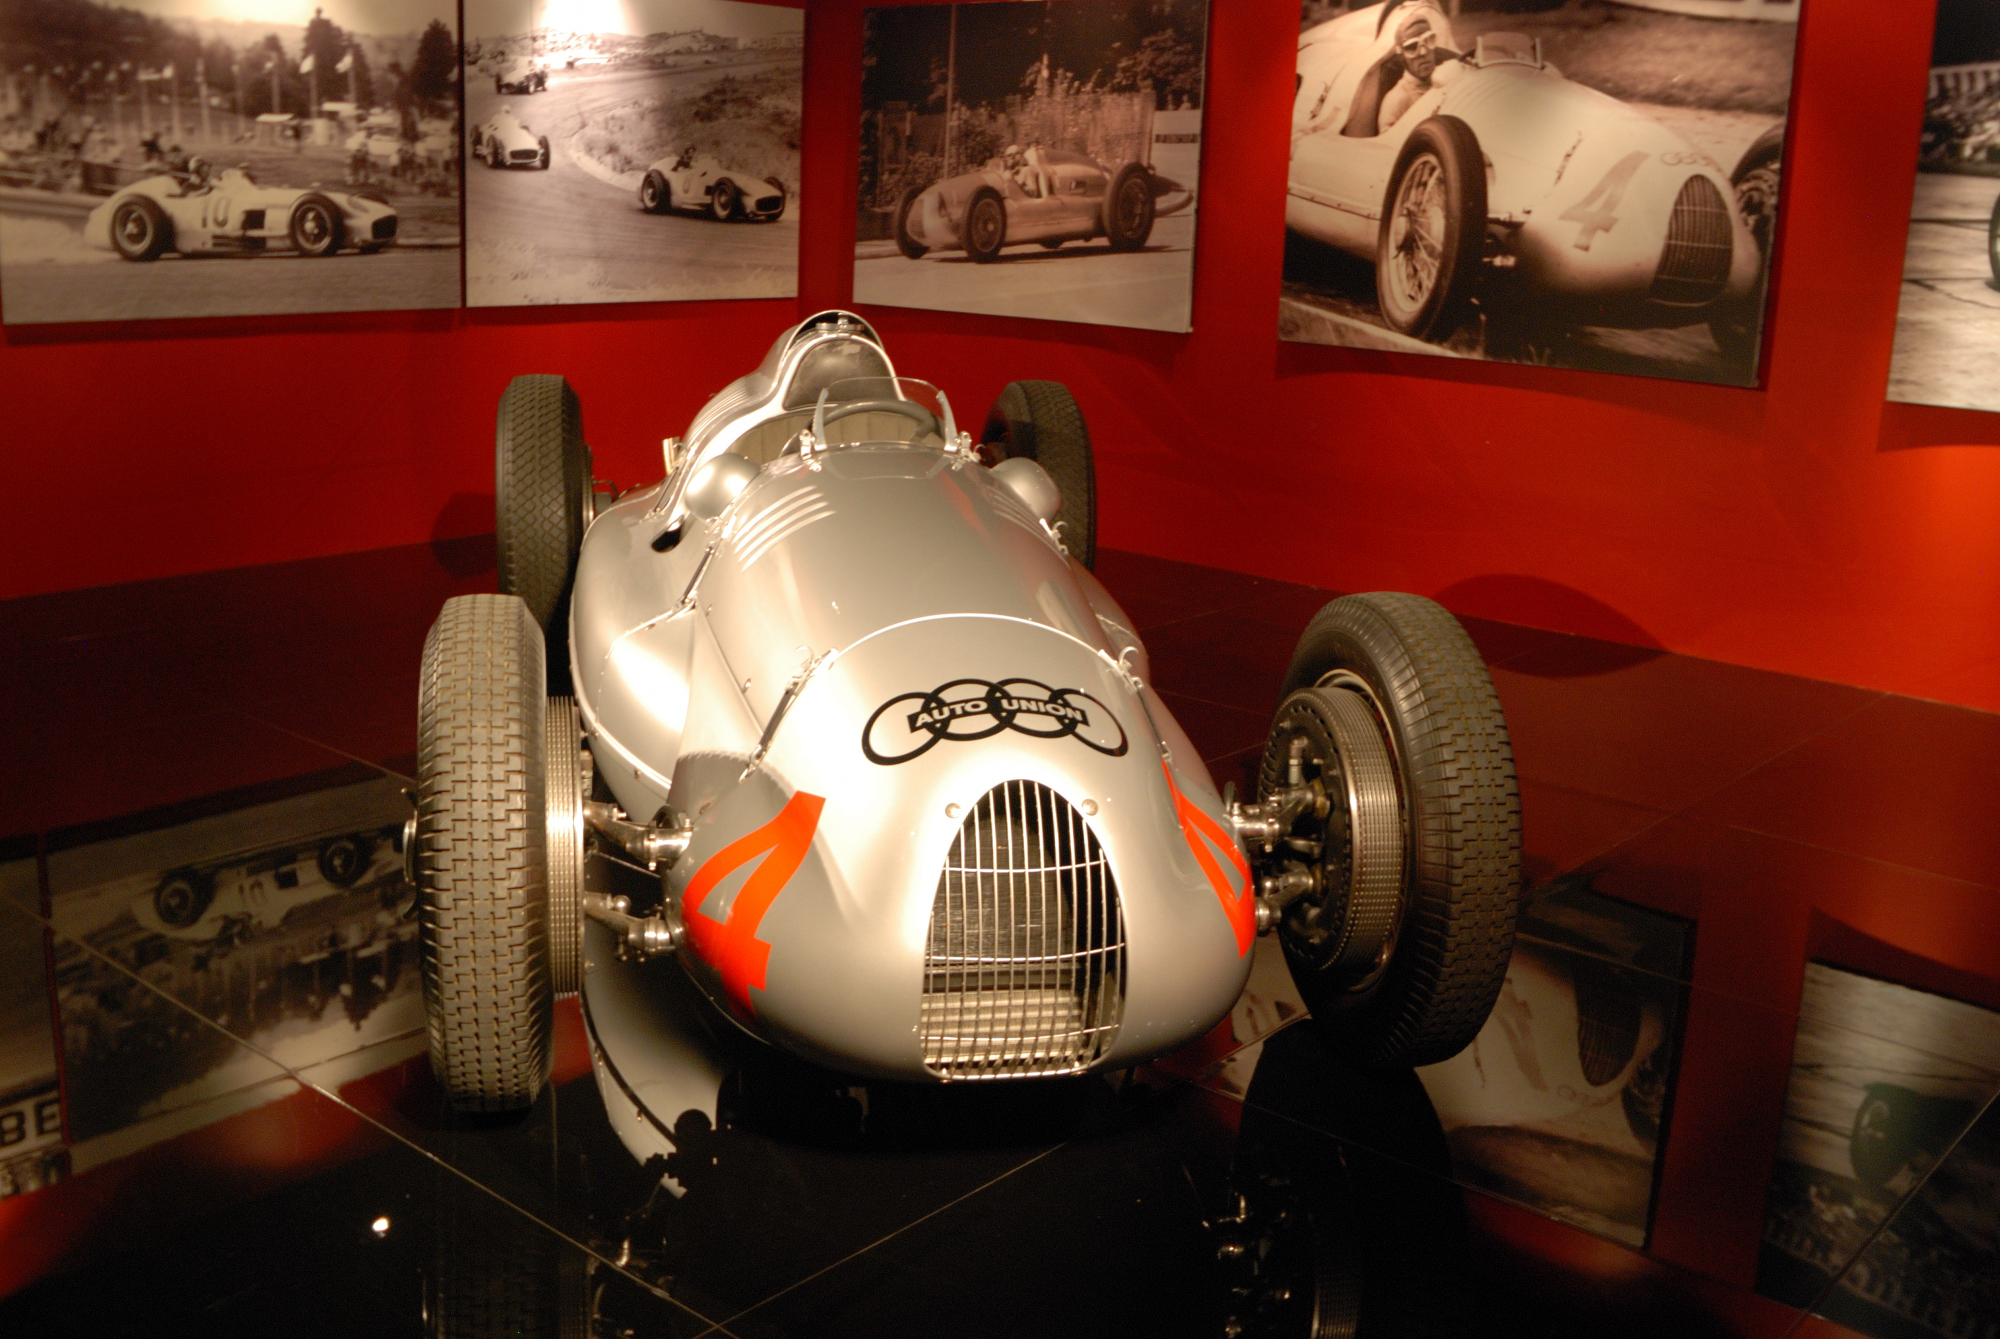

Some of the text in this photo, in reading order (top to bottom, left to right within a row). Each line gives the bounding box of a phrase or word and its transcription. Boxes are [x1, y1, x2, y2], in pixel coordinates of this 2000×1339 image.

[201, 197, 231, 228] 10
[1557, 150, 1650, 253] 4
[914, 698, 1083, 727] AUTO UNION
[680, 790, 827, 1022] 4
